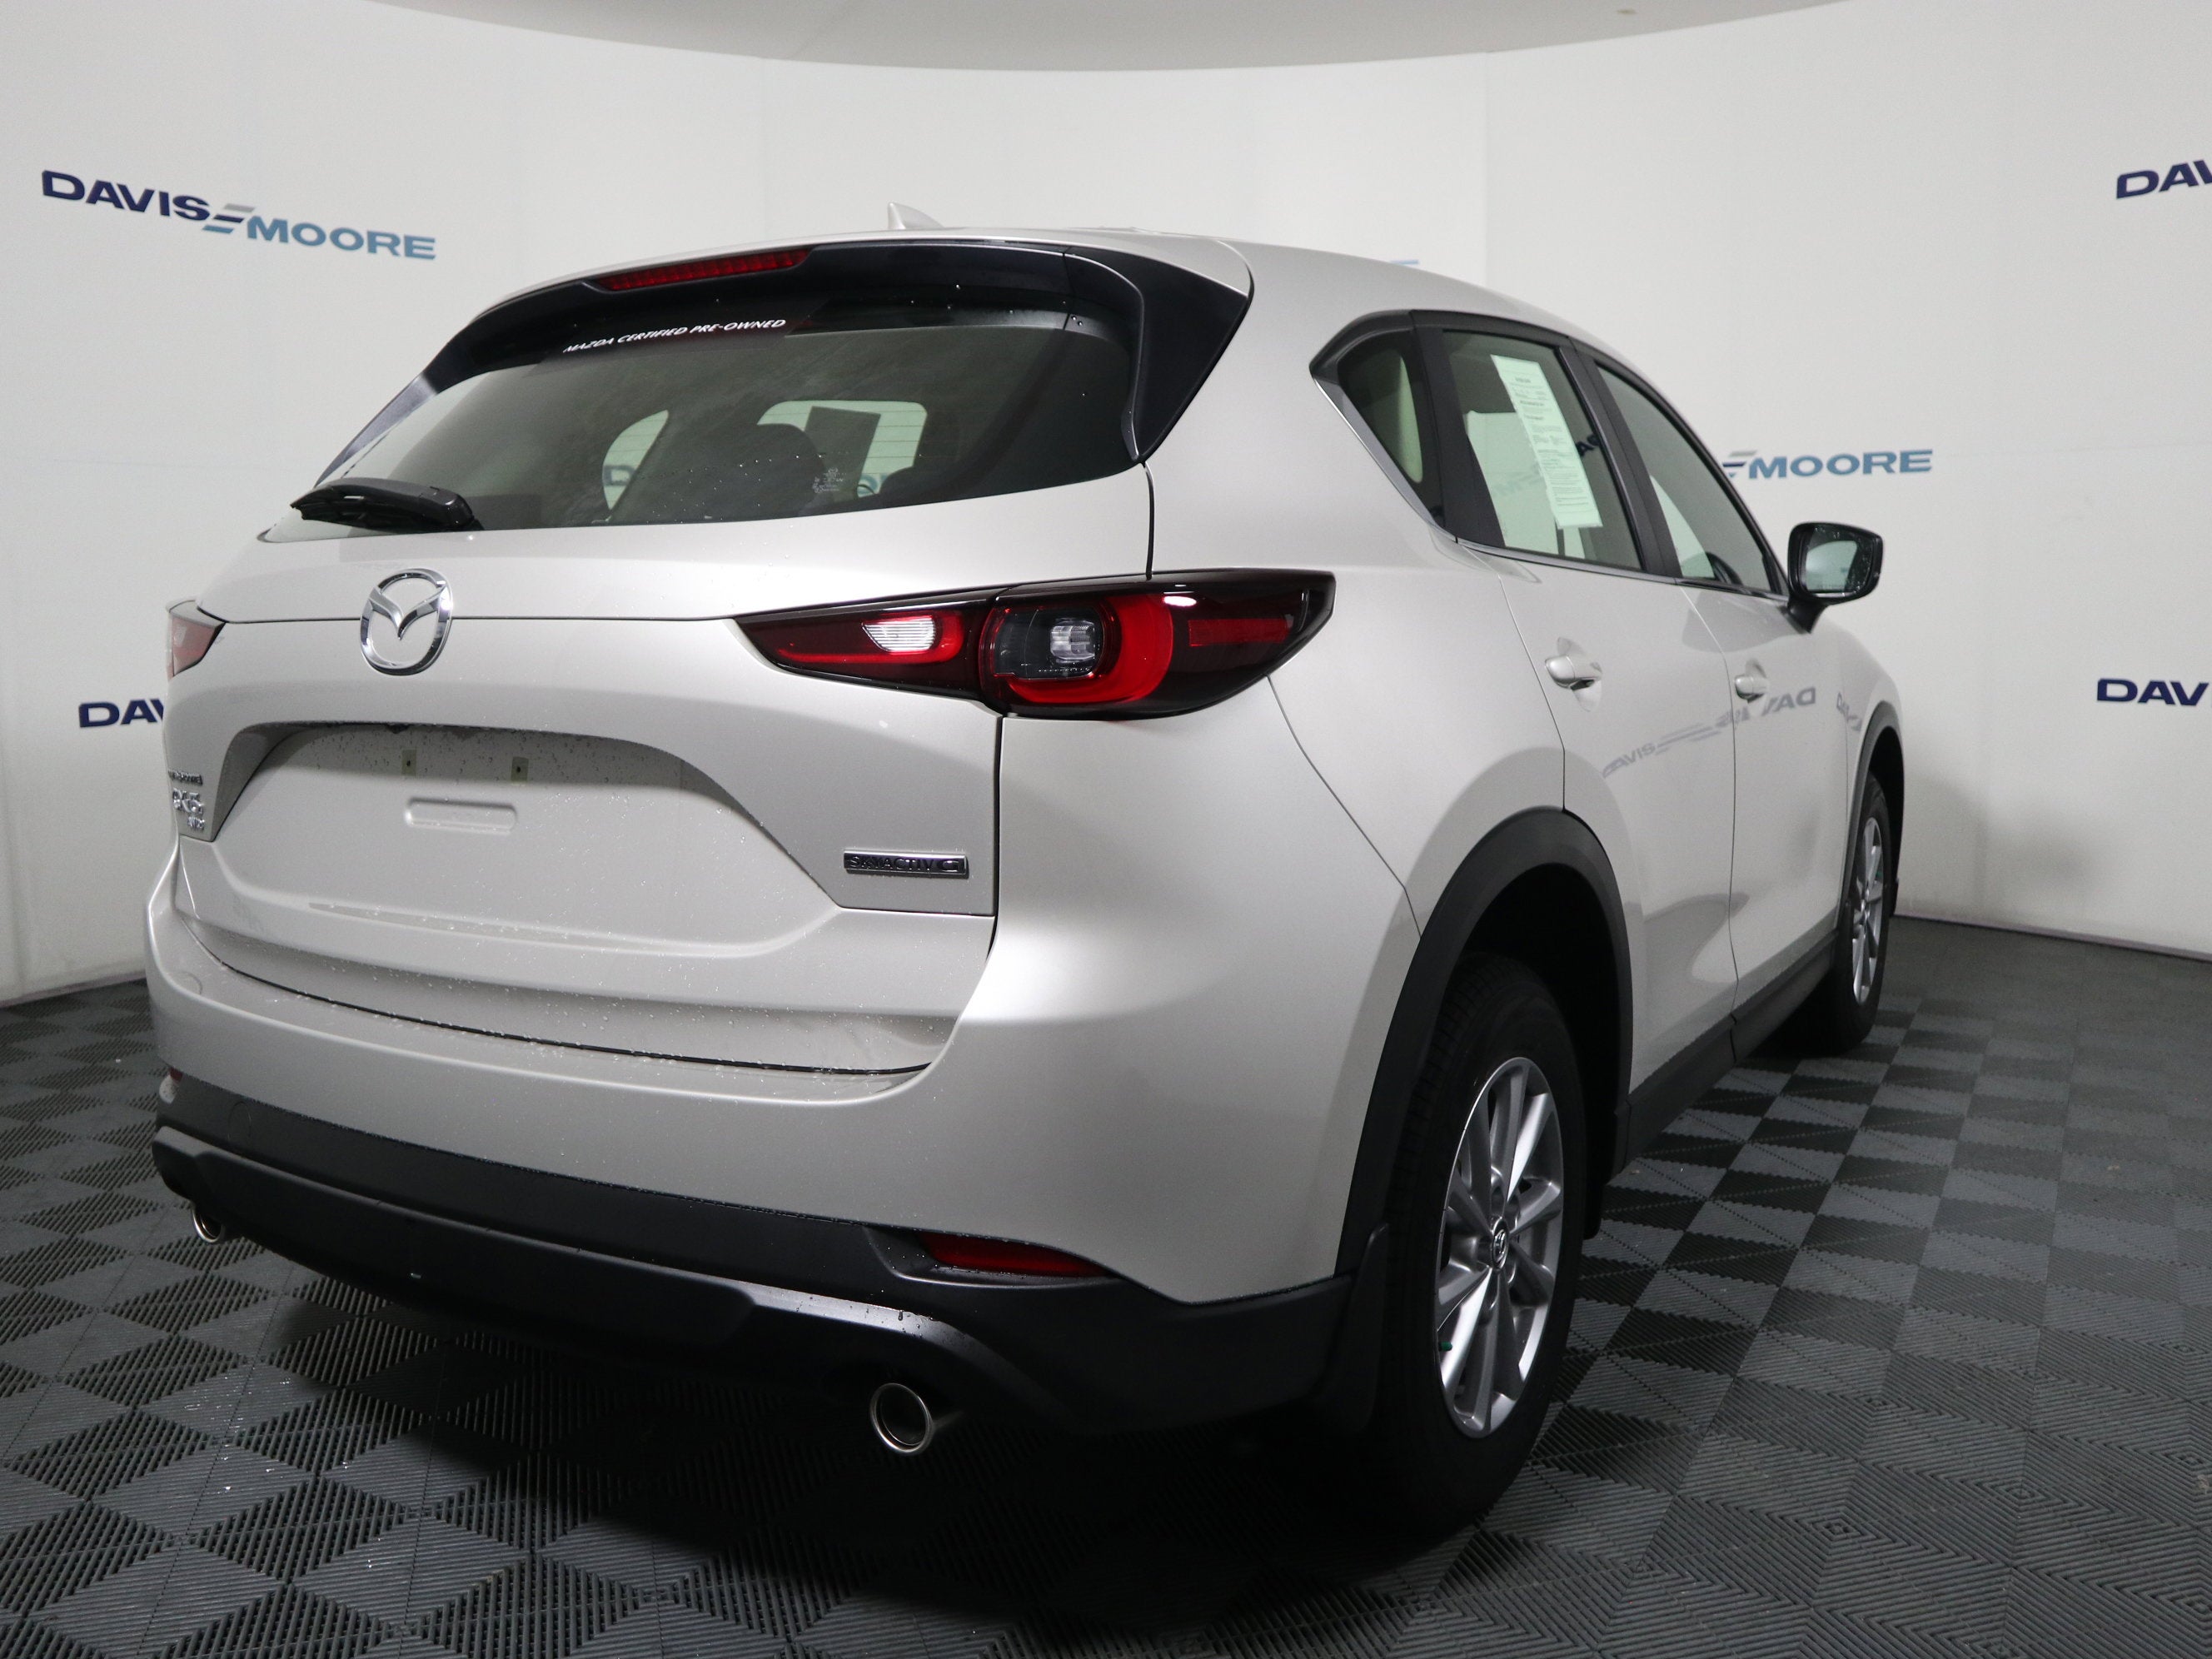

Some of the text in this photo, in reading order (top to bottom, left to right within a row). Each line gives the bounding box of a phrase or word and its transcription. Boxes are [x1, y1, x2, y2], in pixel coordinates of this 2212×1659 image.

[42, 170, 436, 261] DAVIS MOORE
[562, 319, 787, 353] MAZDA CERTIFIED PRE-OWNED
[1748, 449, 1933, 480] MOORE
